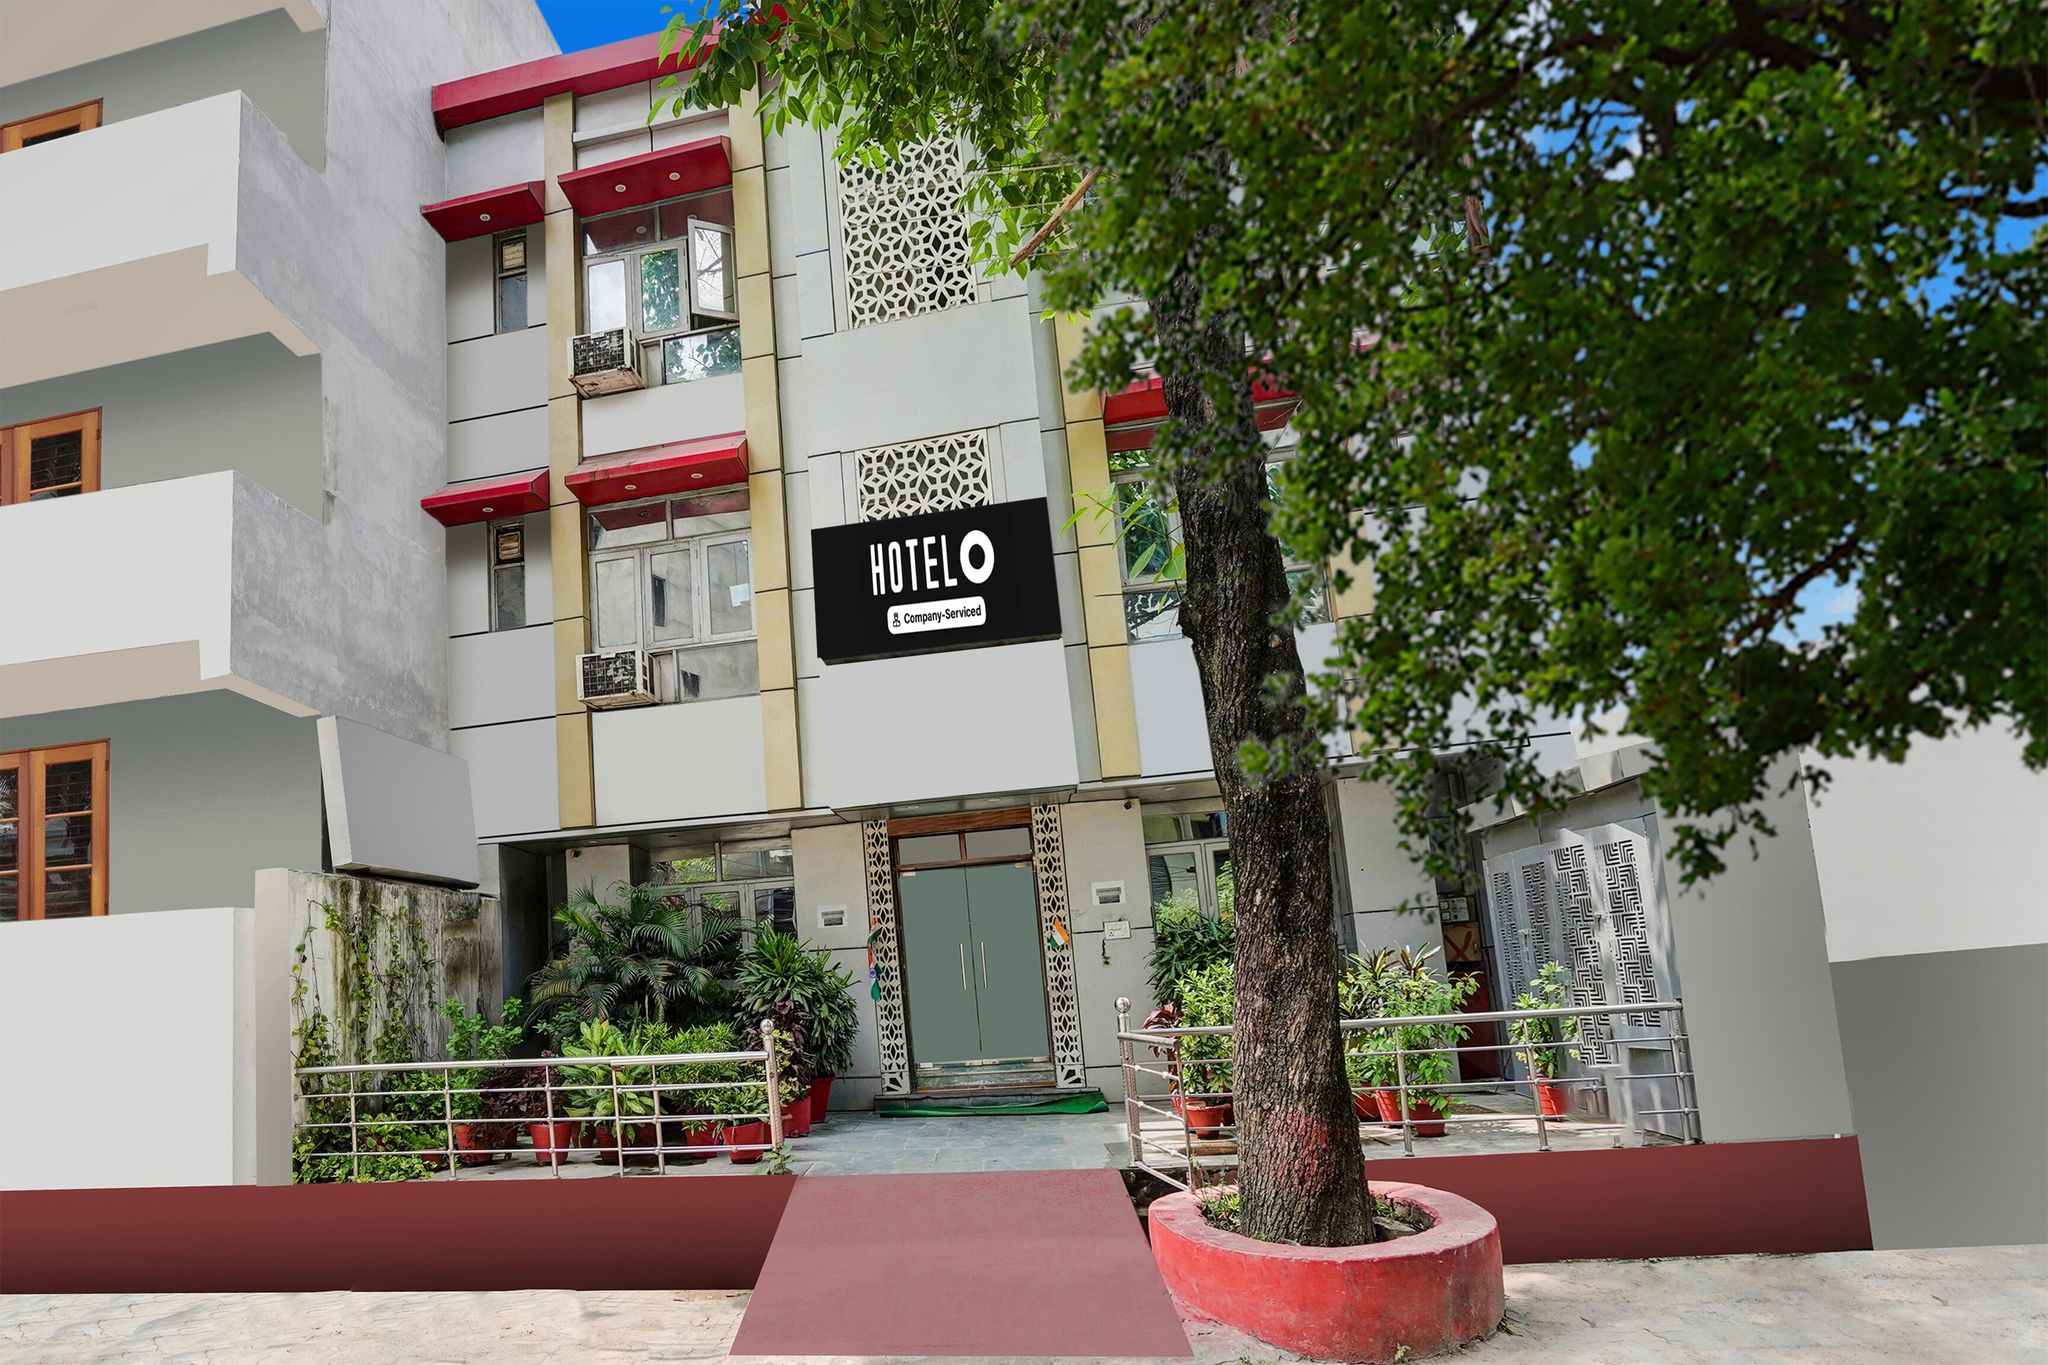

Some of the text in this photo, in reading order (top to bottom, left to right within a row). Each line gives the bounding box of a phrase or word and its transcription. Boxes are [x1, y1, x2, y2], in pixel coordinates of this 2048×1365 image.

[869, 529, 995, 596] HOTEL O
[903, 604, 982, 625] Company-Serviced
